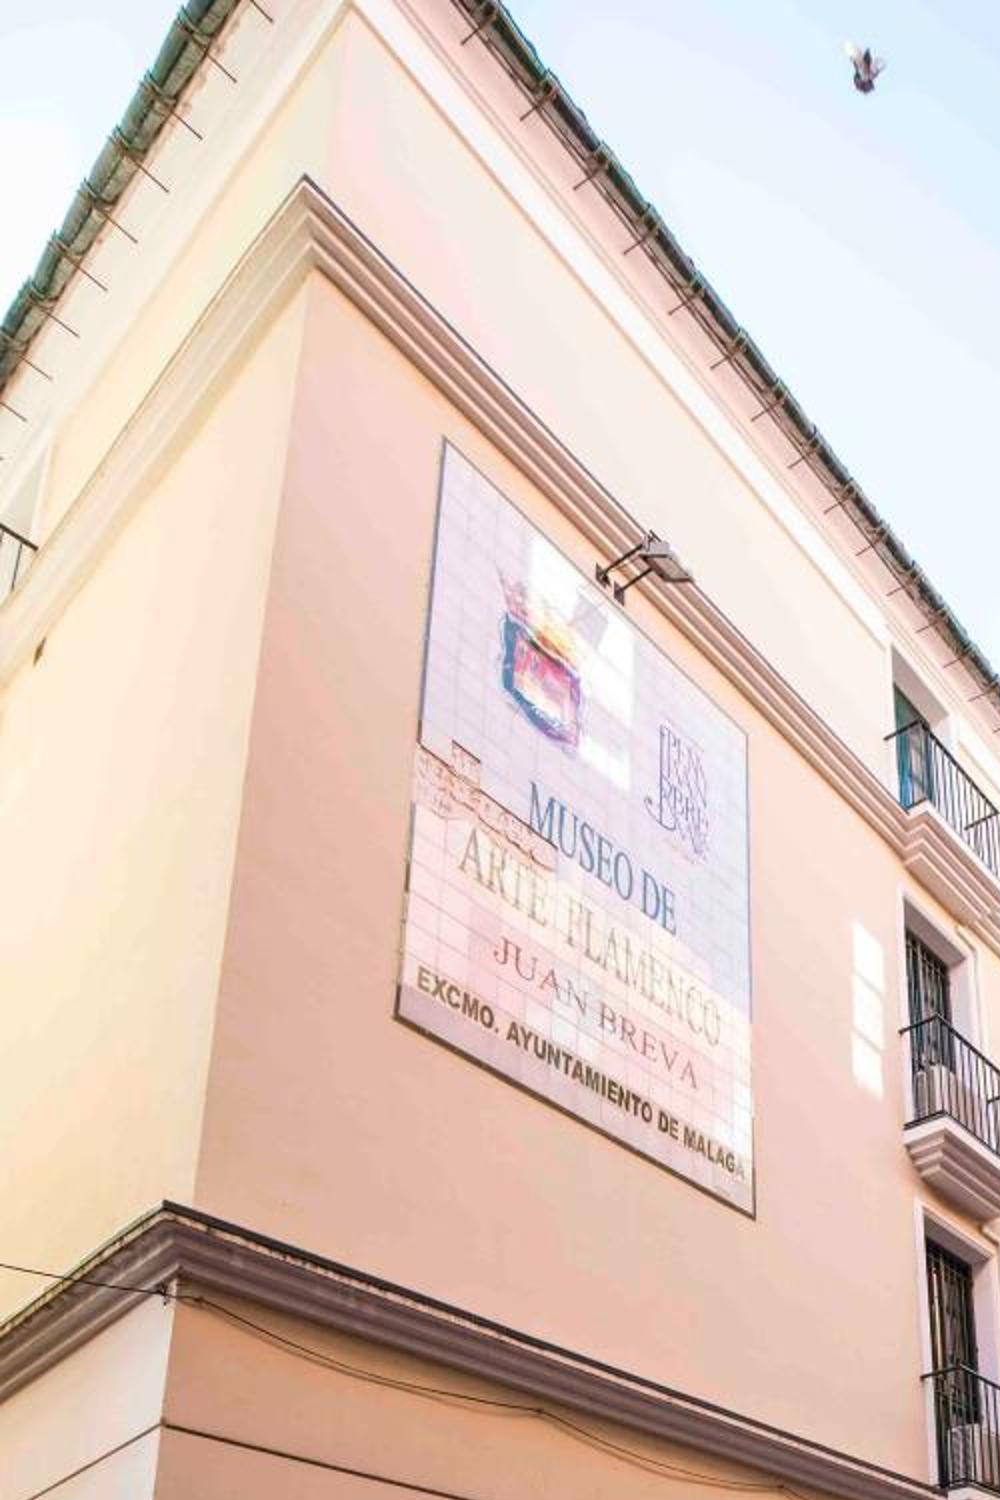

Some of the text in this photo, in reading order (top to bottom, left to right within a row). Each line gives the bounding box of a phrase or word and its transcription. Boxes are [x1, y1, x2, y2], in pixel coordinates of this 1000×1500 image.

[458, 827, 721, 1047] ARTE FLAMENCO
[530, 780, 633, 900] MUSEO
[640, 867, 676, 935] DE
[416, 966, 500, 1034] EXCMO.
[506, 1021, 653, 1124] AYUNTAMIENTO
[656, 1110, 680, 1141] DE
[494, 936, 697, 1089] JUAN BREVA
